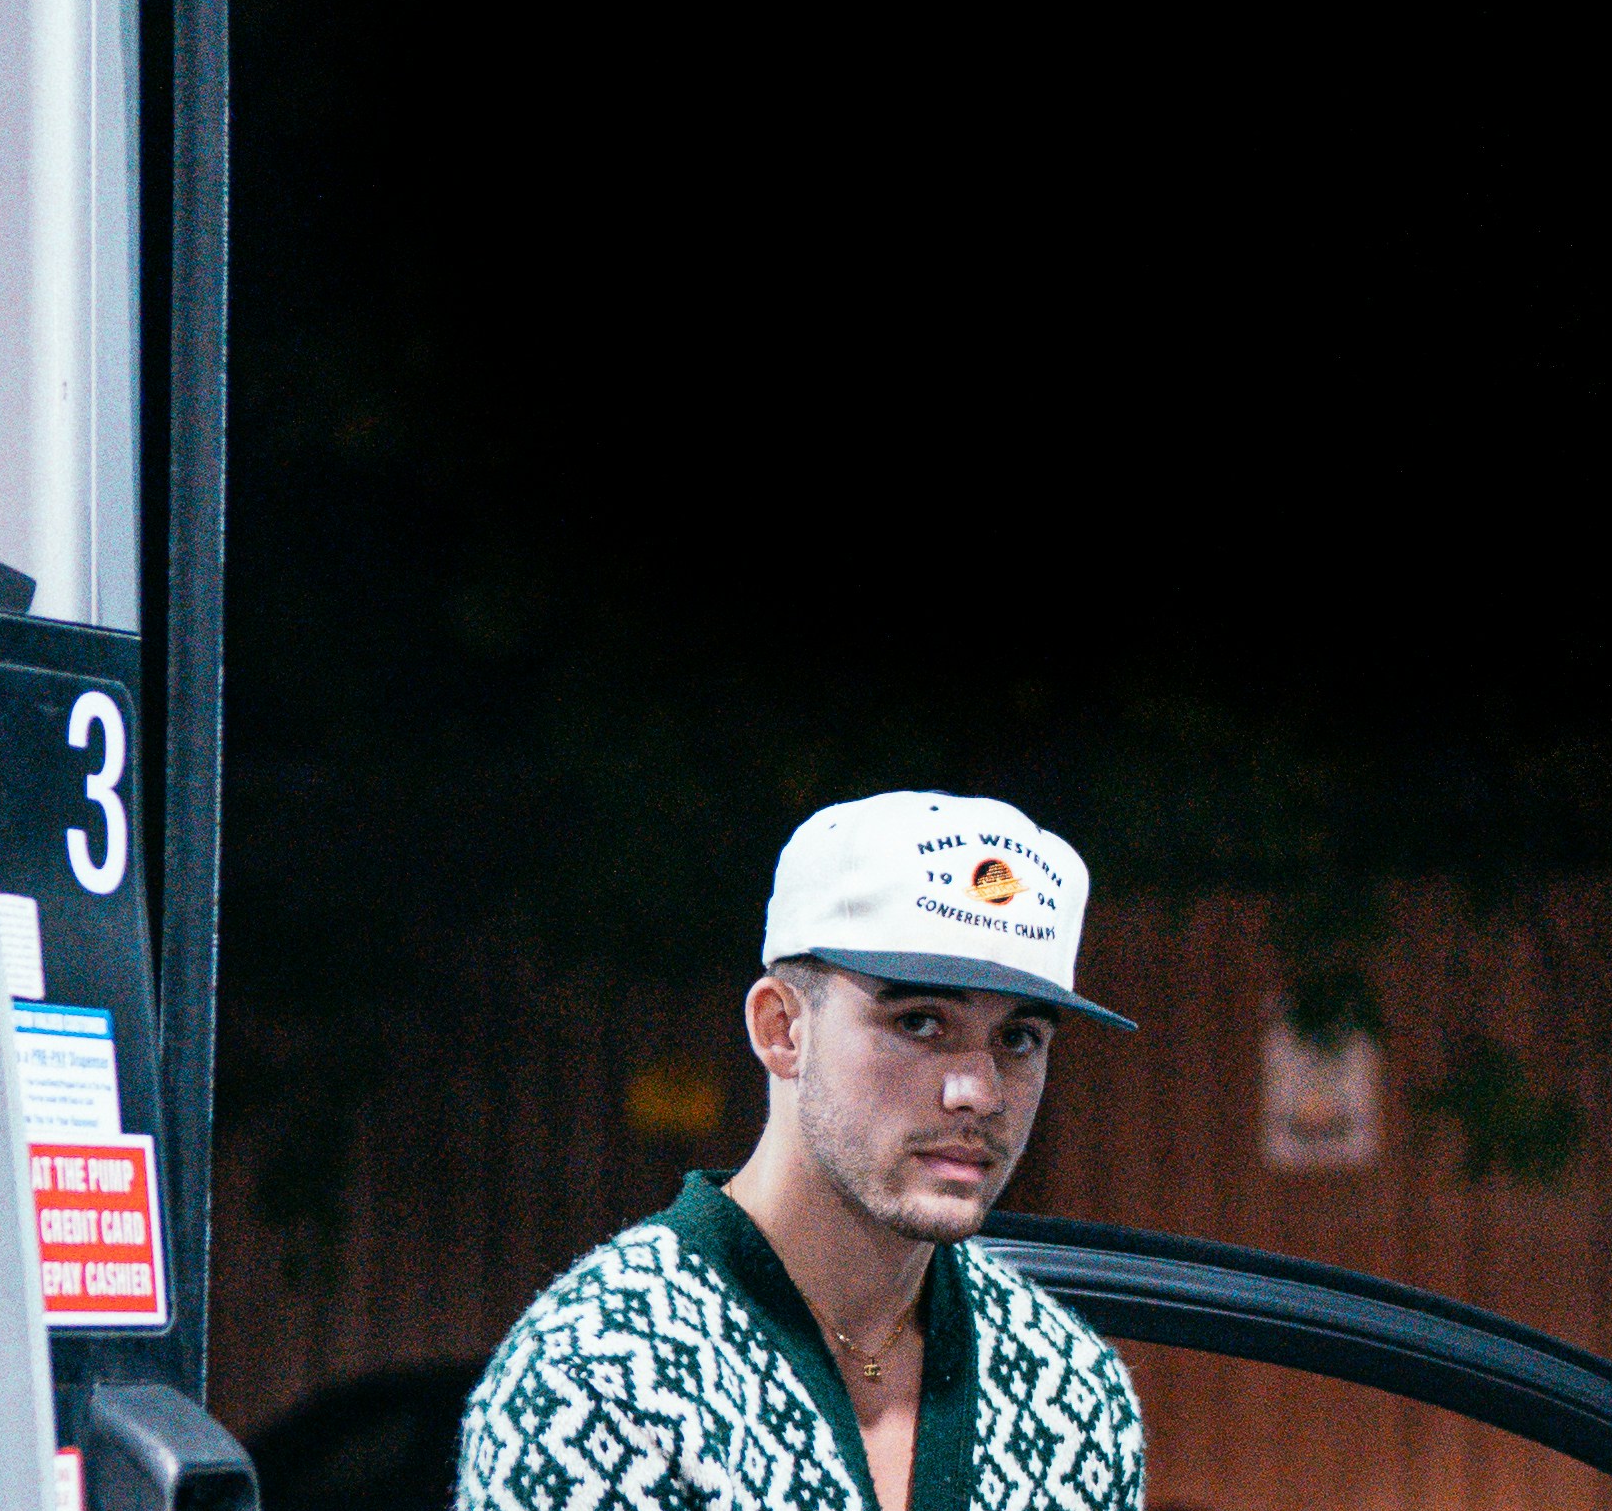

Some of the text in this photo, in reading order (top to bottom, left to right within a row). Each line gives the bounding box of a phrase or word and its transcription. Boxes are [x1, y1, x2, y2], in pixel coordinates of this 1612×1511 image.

[66, 689, 128, 896] 3
[917, 833, 967, 855] NHL
[978, 832, 1063, 889] WESTERN
[925, 870, 1057, 911] 19 94
[916, 895, 1009, 934] CONFERENCE
[31, 1156, 134, 1193] AT THE PUMP
[40, 1208, 147, 1246] CREDIT CARD
[84, 1260, 153, 1297] CASHIER
